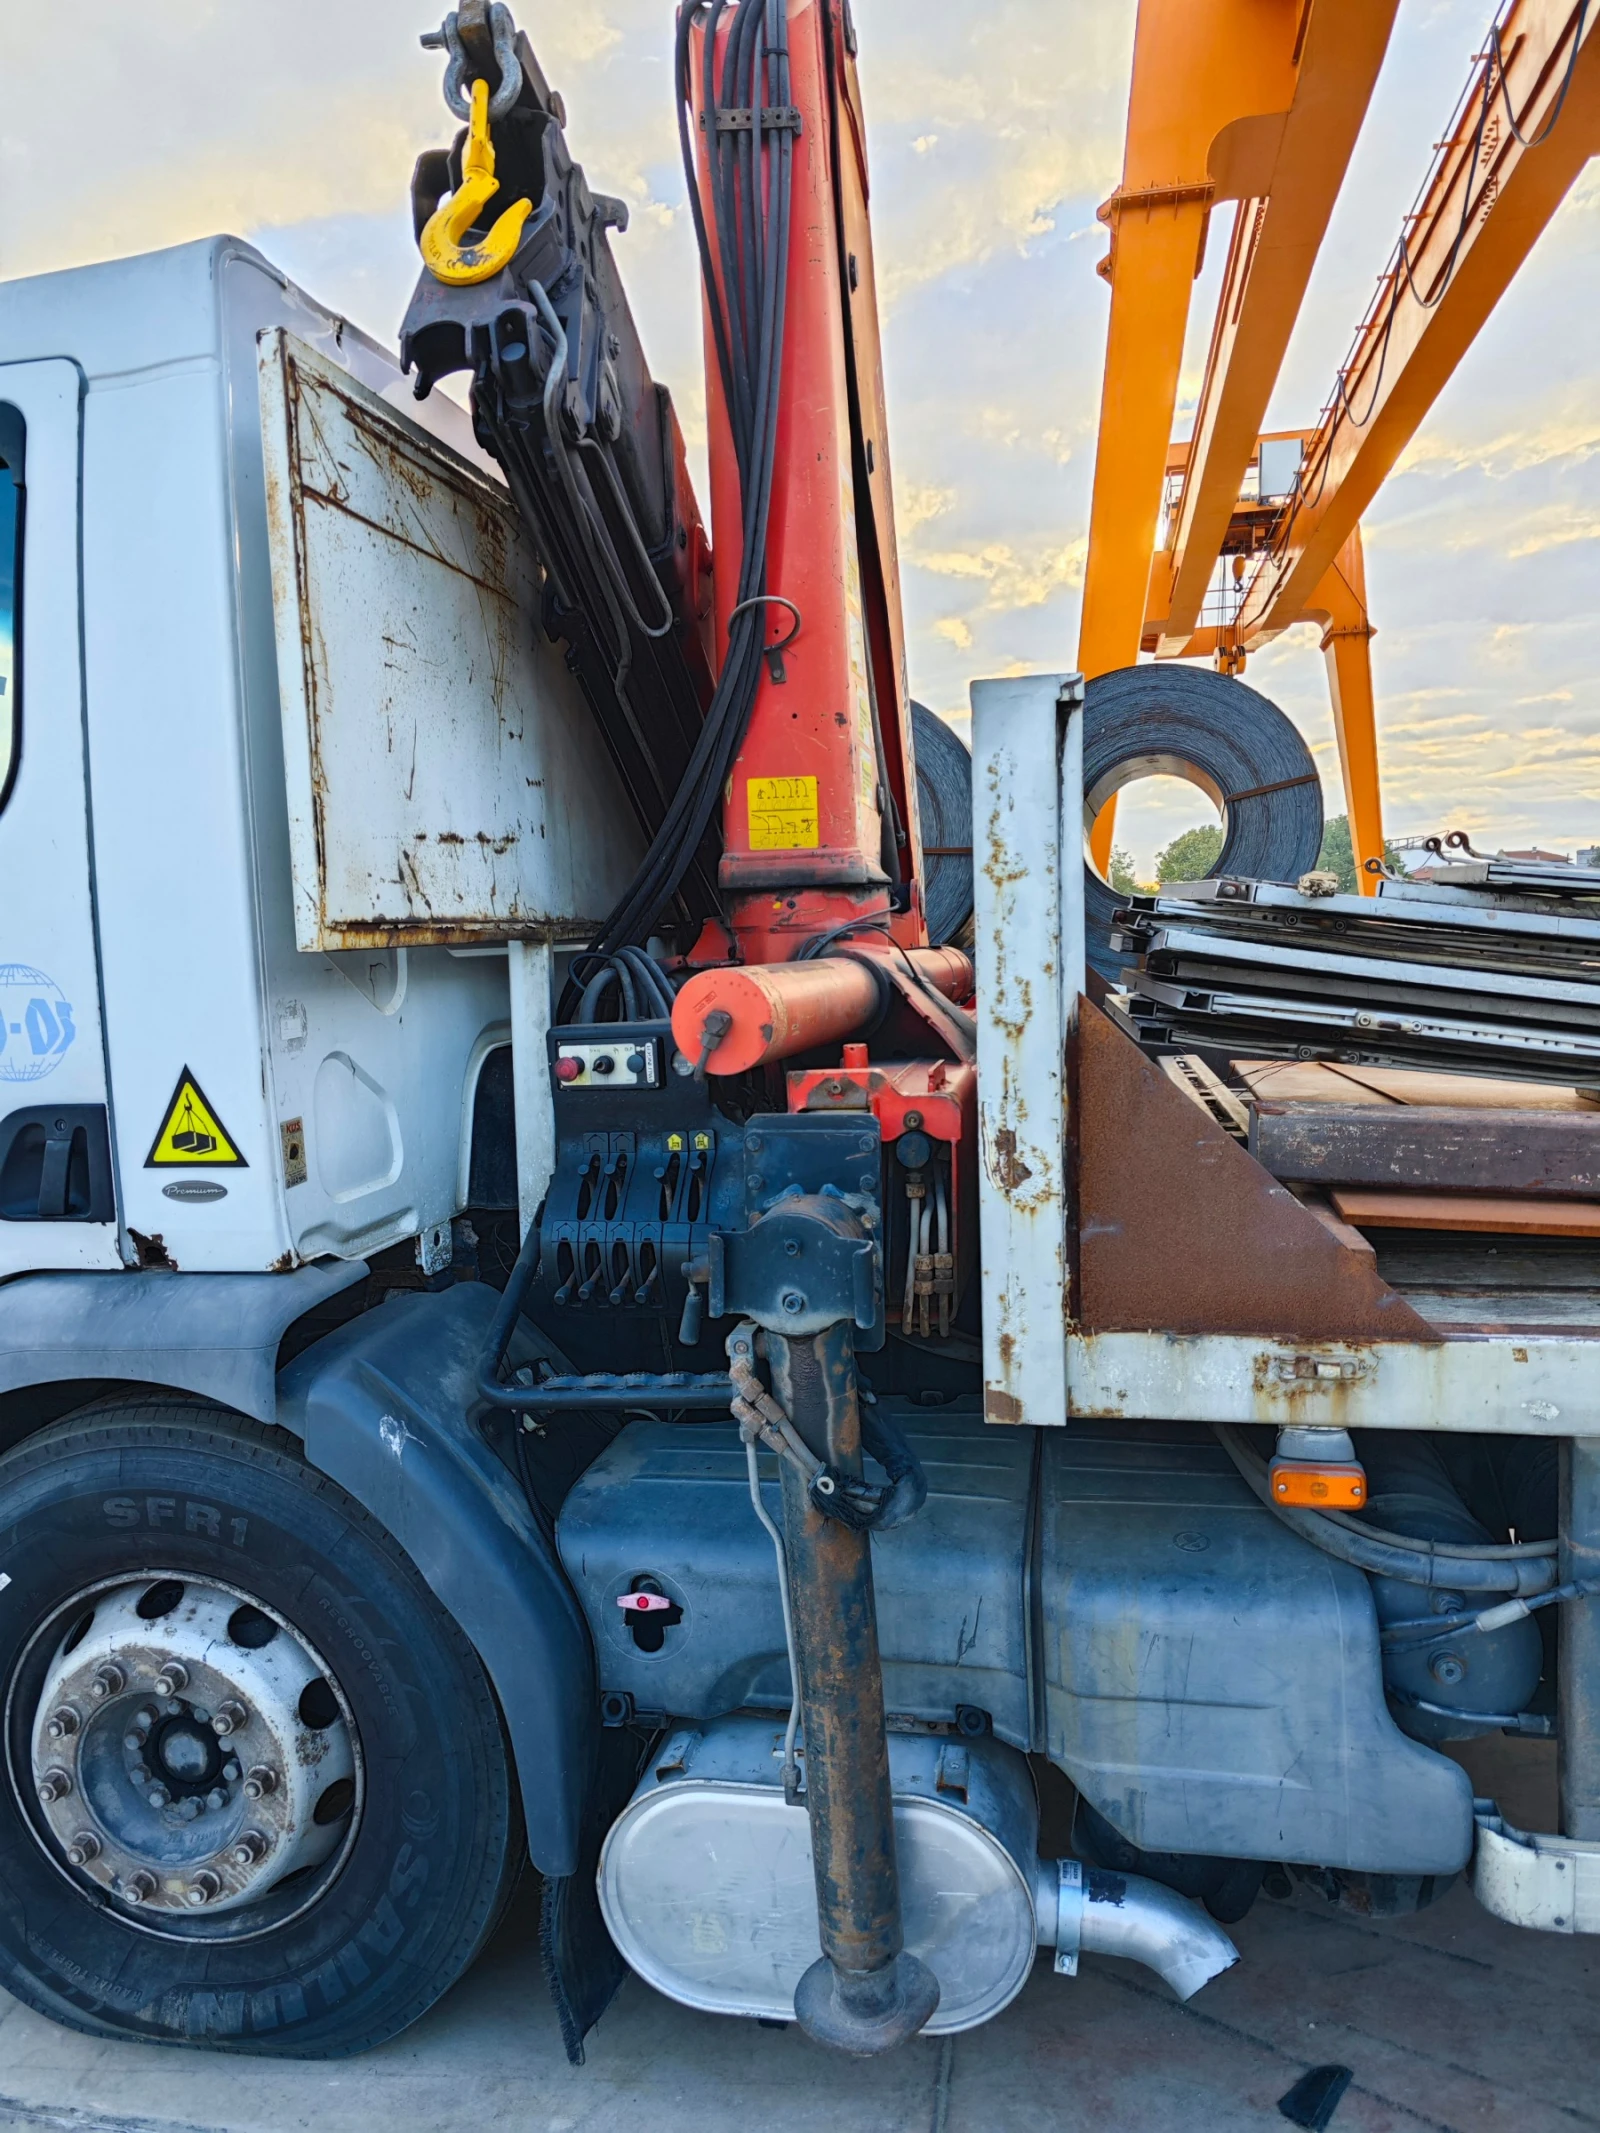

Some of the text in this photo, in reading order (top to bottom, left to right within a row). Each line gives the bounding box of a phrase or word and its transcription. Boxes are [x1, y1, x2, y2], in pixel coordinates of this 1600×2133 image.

[165, 1185, 224, 1196] Premium
[103, 1496, 249, 1548] SFR1
[318, 1597, 400, 1716] REGROOVABLE
[186, 1843, 429, 2036] SAILUN
